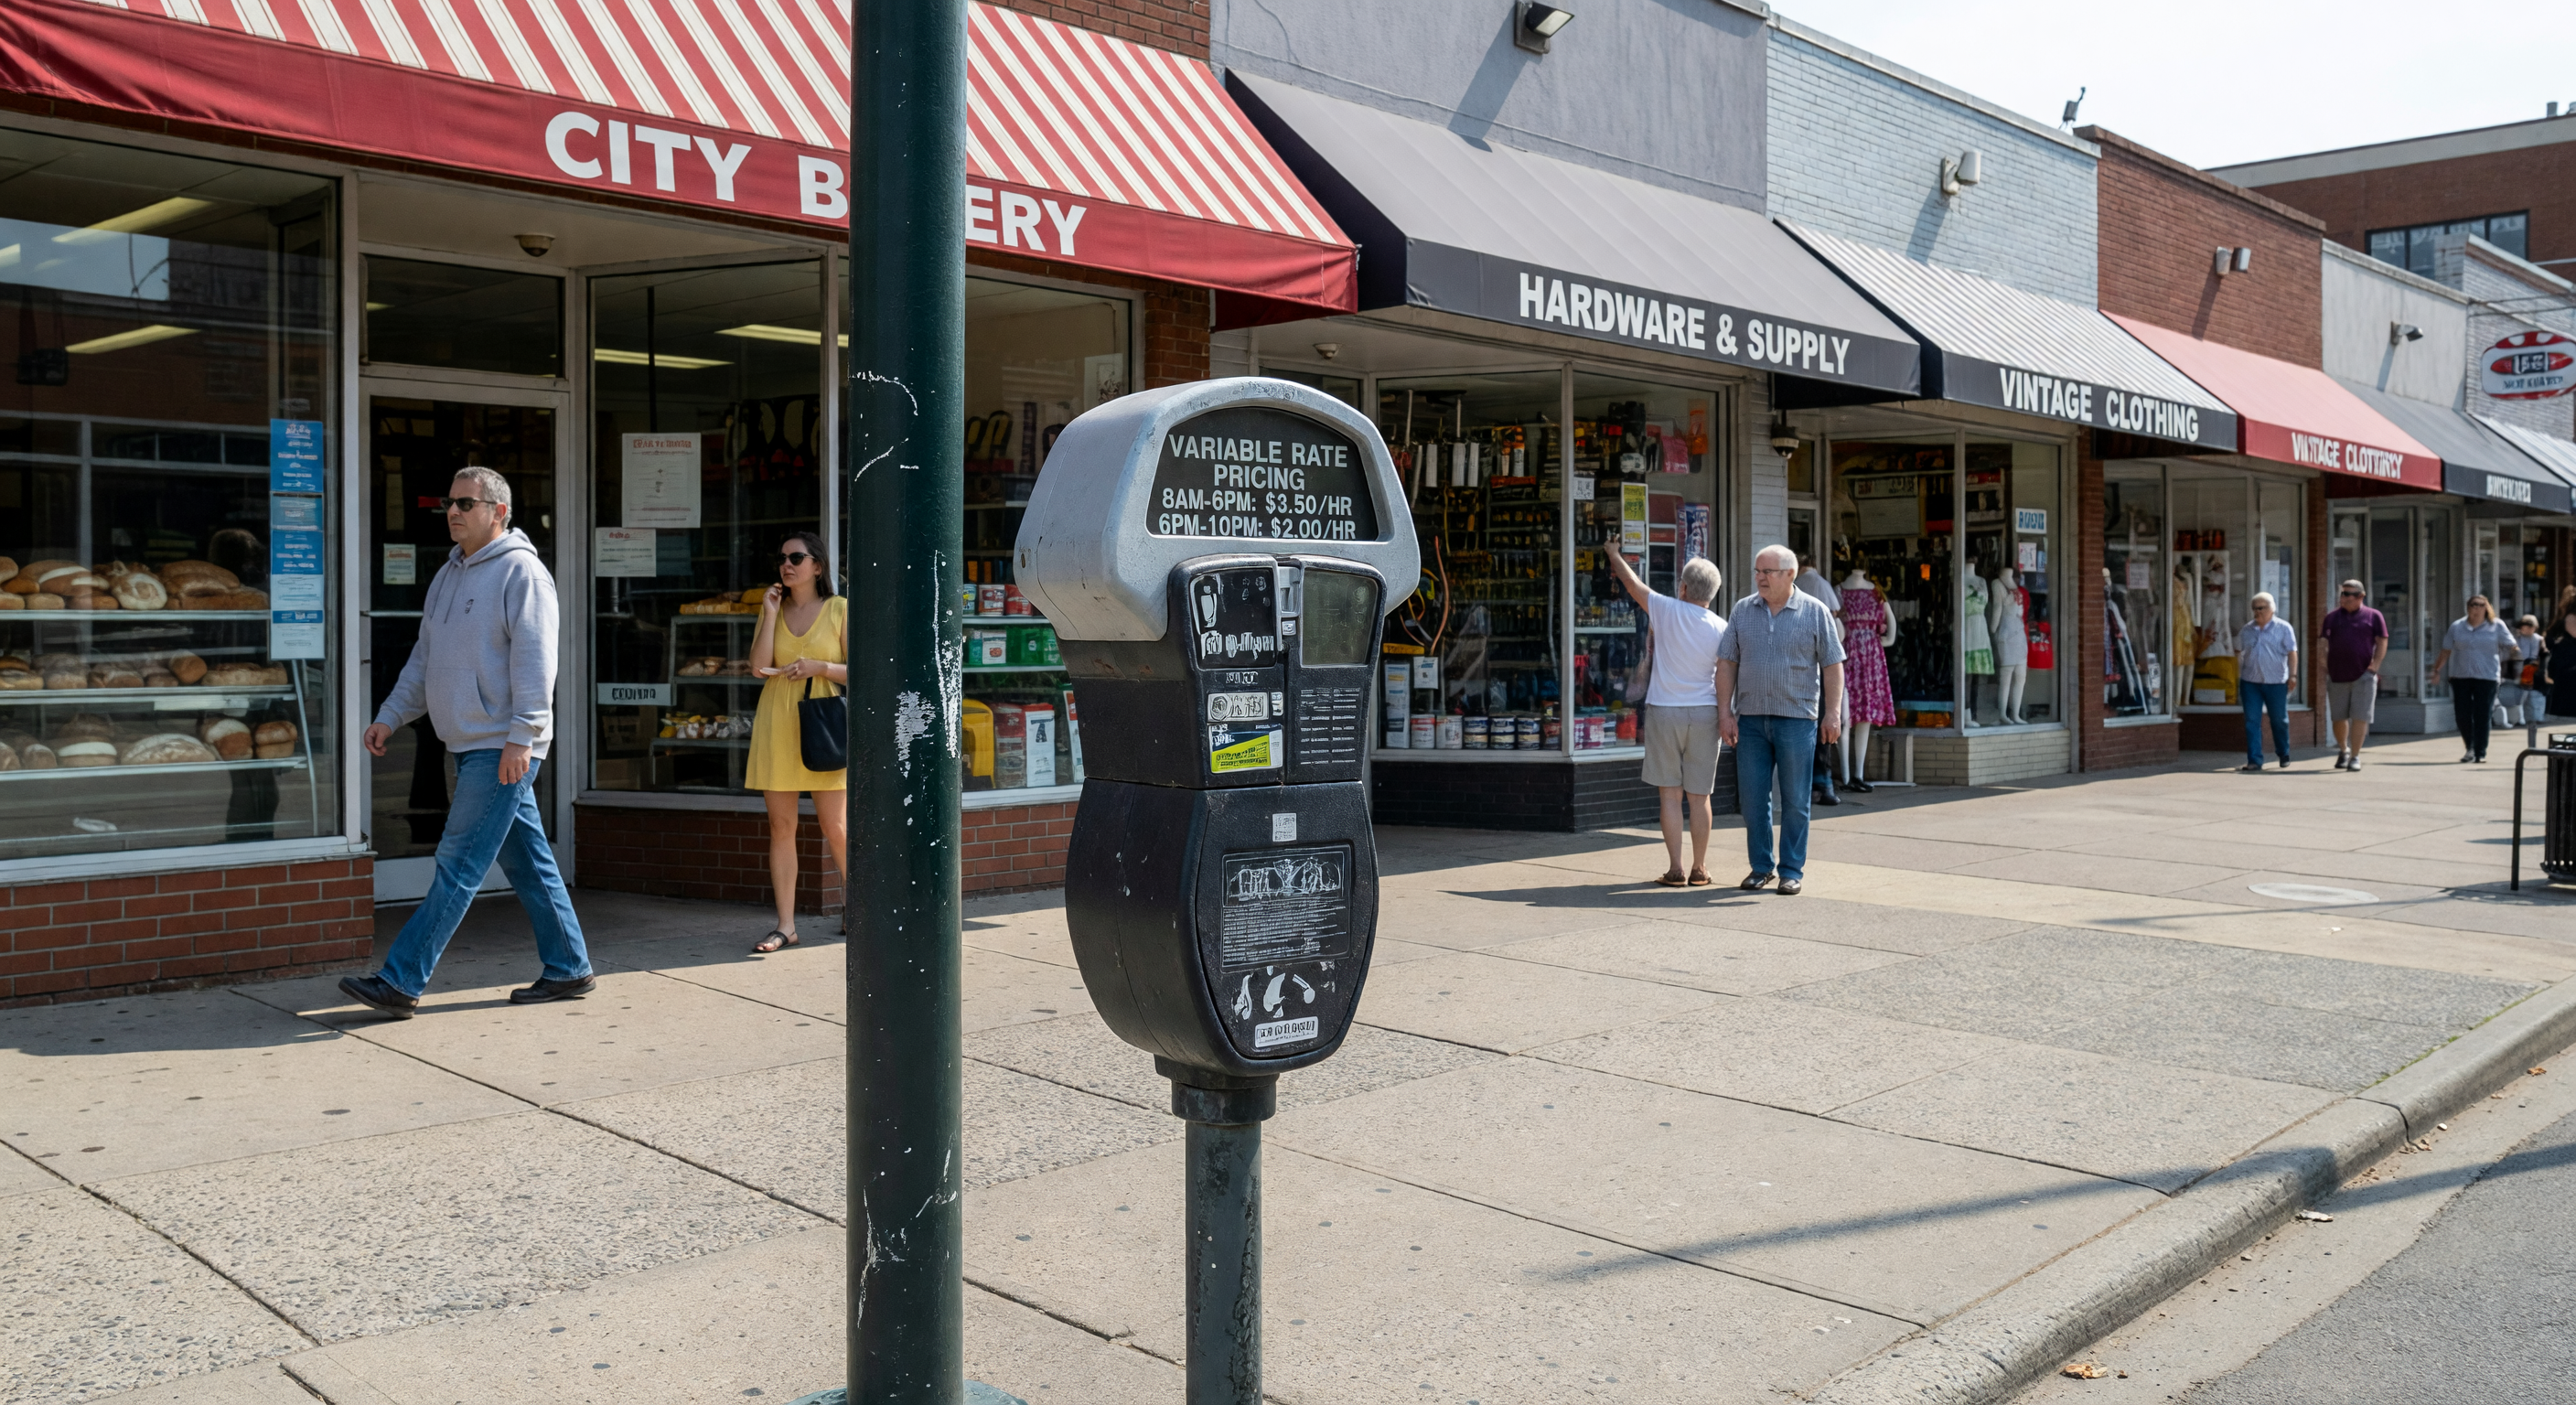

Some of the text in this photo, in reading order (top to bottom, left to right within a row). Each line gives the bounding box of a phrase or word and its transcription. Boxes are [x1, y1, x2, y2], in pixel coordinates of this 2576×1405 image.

[545, 111, 1088, 256] CITY BERY
[1519, 273, 1850, 375] HARDWARE & SUPPLY
[2000, 368, 2199, 442] VINTAGE CLOTHING
[1168, 434, 1348, 467] VARIABLE RATE
[1214, 464, 1305, 490] PRICING
[1162, 488, 1256, 511] 8AM-6PM:
[1159, 512, 1356, 540] 6PM-10PM: $2.00/HR
